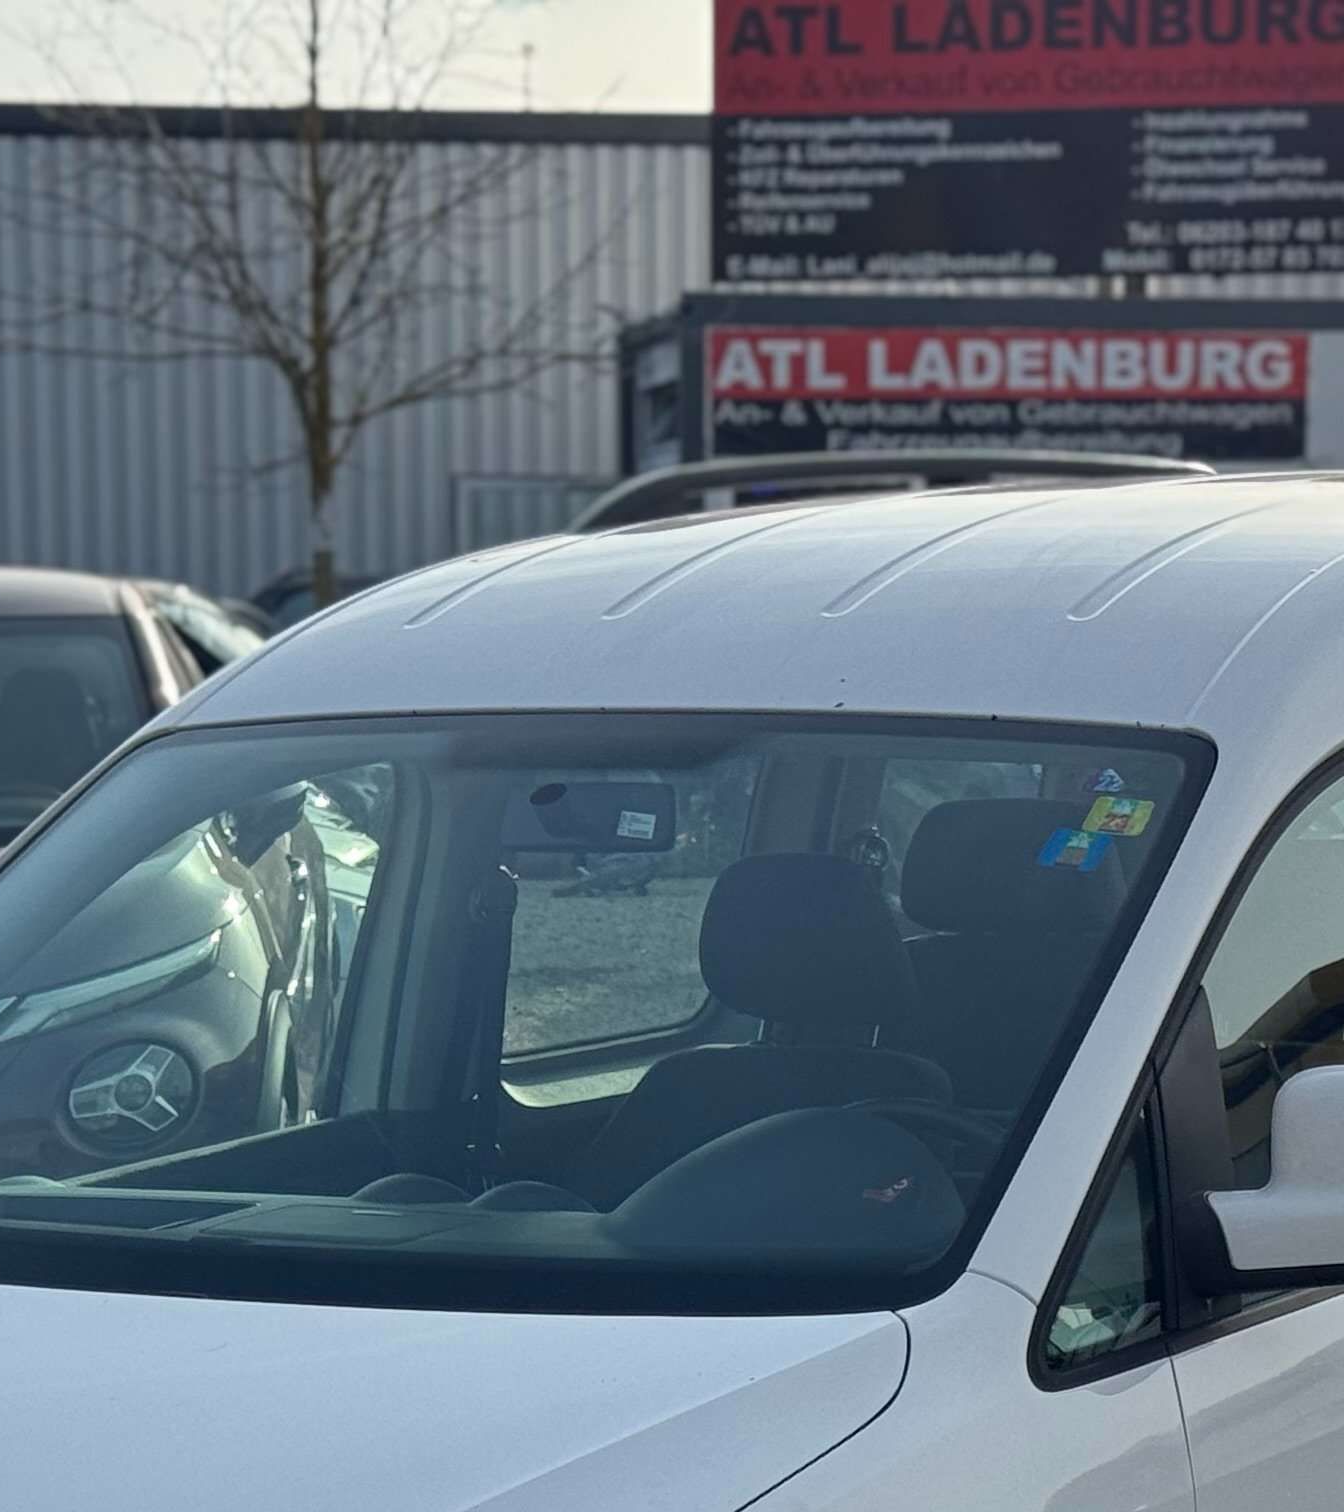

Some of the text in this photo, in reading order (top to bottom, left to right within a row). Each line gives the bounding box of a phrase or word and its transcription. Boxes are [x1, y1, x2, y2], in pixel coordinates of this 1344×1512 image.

[728, 4, 864, 57] ATL
[834, 61, 968, 98] Verkauf
[979, 69, 1040, 95] von
[715, 338, 1293, 391] ATL LADENBURG
[715, 397, 1295, 430] An- & Verkauf von Gebrauchtwagen
